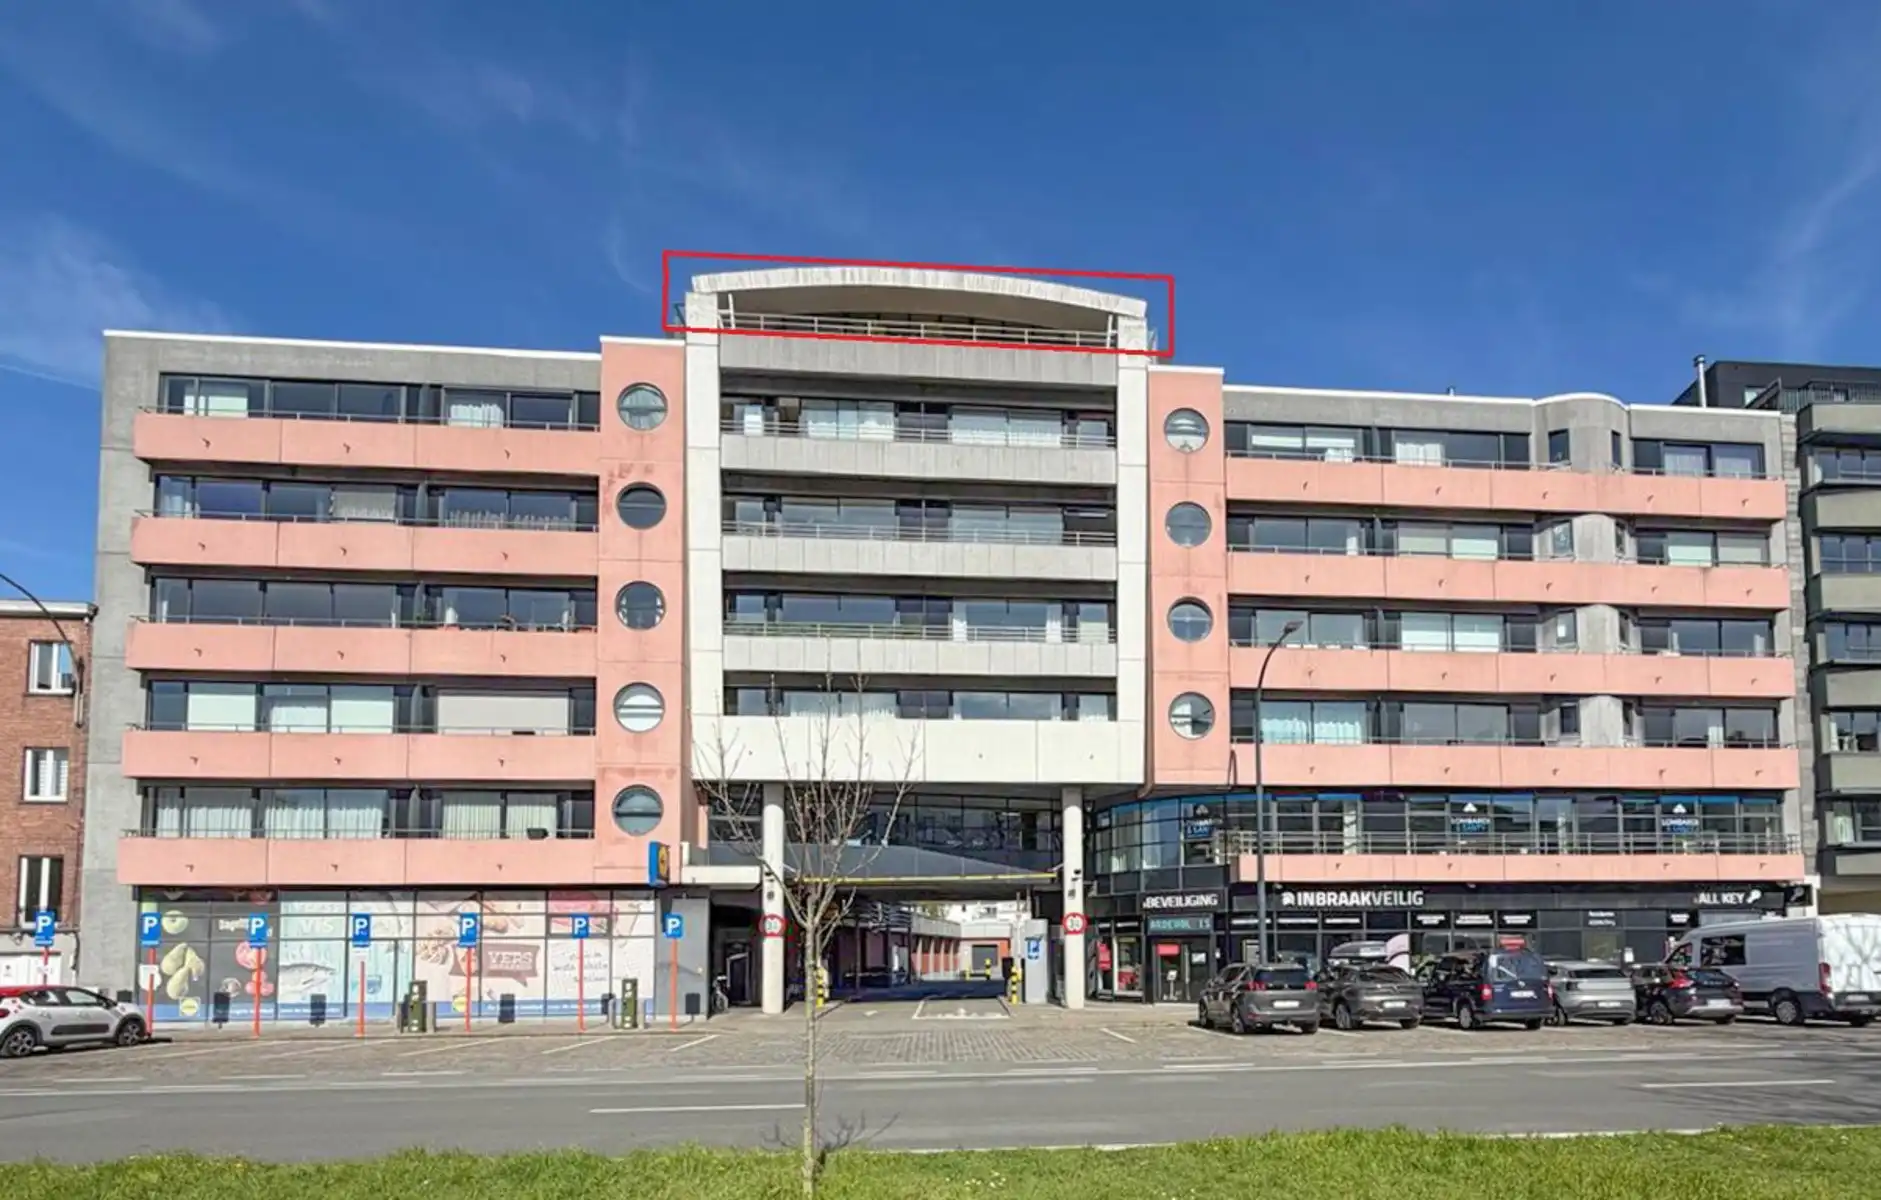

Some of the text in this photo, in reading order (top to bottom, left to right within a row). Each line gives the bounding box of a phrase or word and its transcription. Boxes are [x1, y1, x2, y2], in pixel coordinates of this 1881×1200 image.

[1297, 890, 1424, 906] INBRAAKVEILIG
[1698, 892, 1746, 905] ALL KEY
[37, 915, 52, 933] P
[143, 916, 158, 934] P
[250, 917, 265, 935] P
[355, 918, 368, 935] P
[461, 918, 475, 935] P
[573, 917, 587, 934] P
[667, 918, 680, 935] P
[487, 951, 532, 963] VERS
